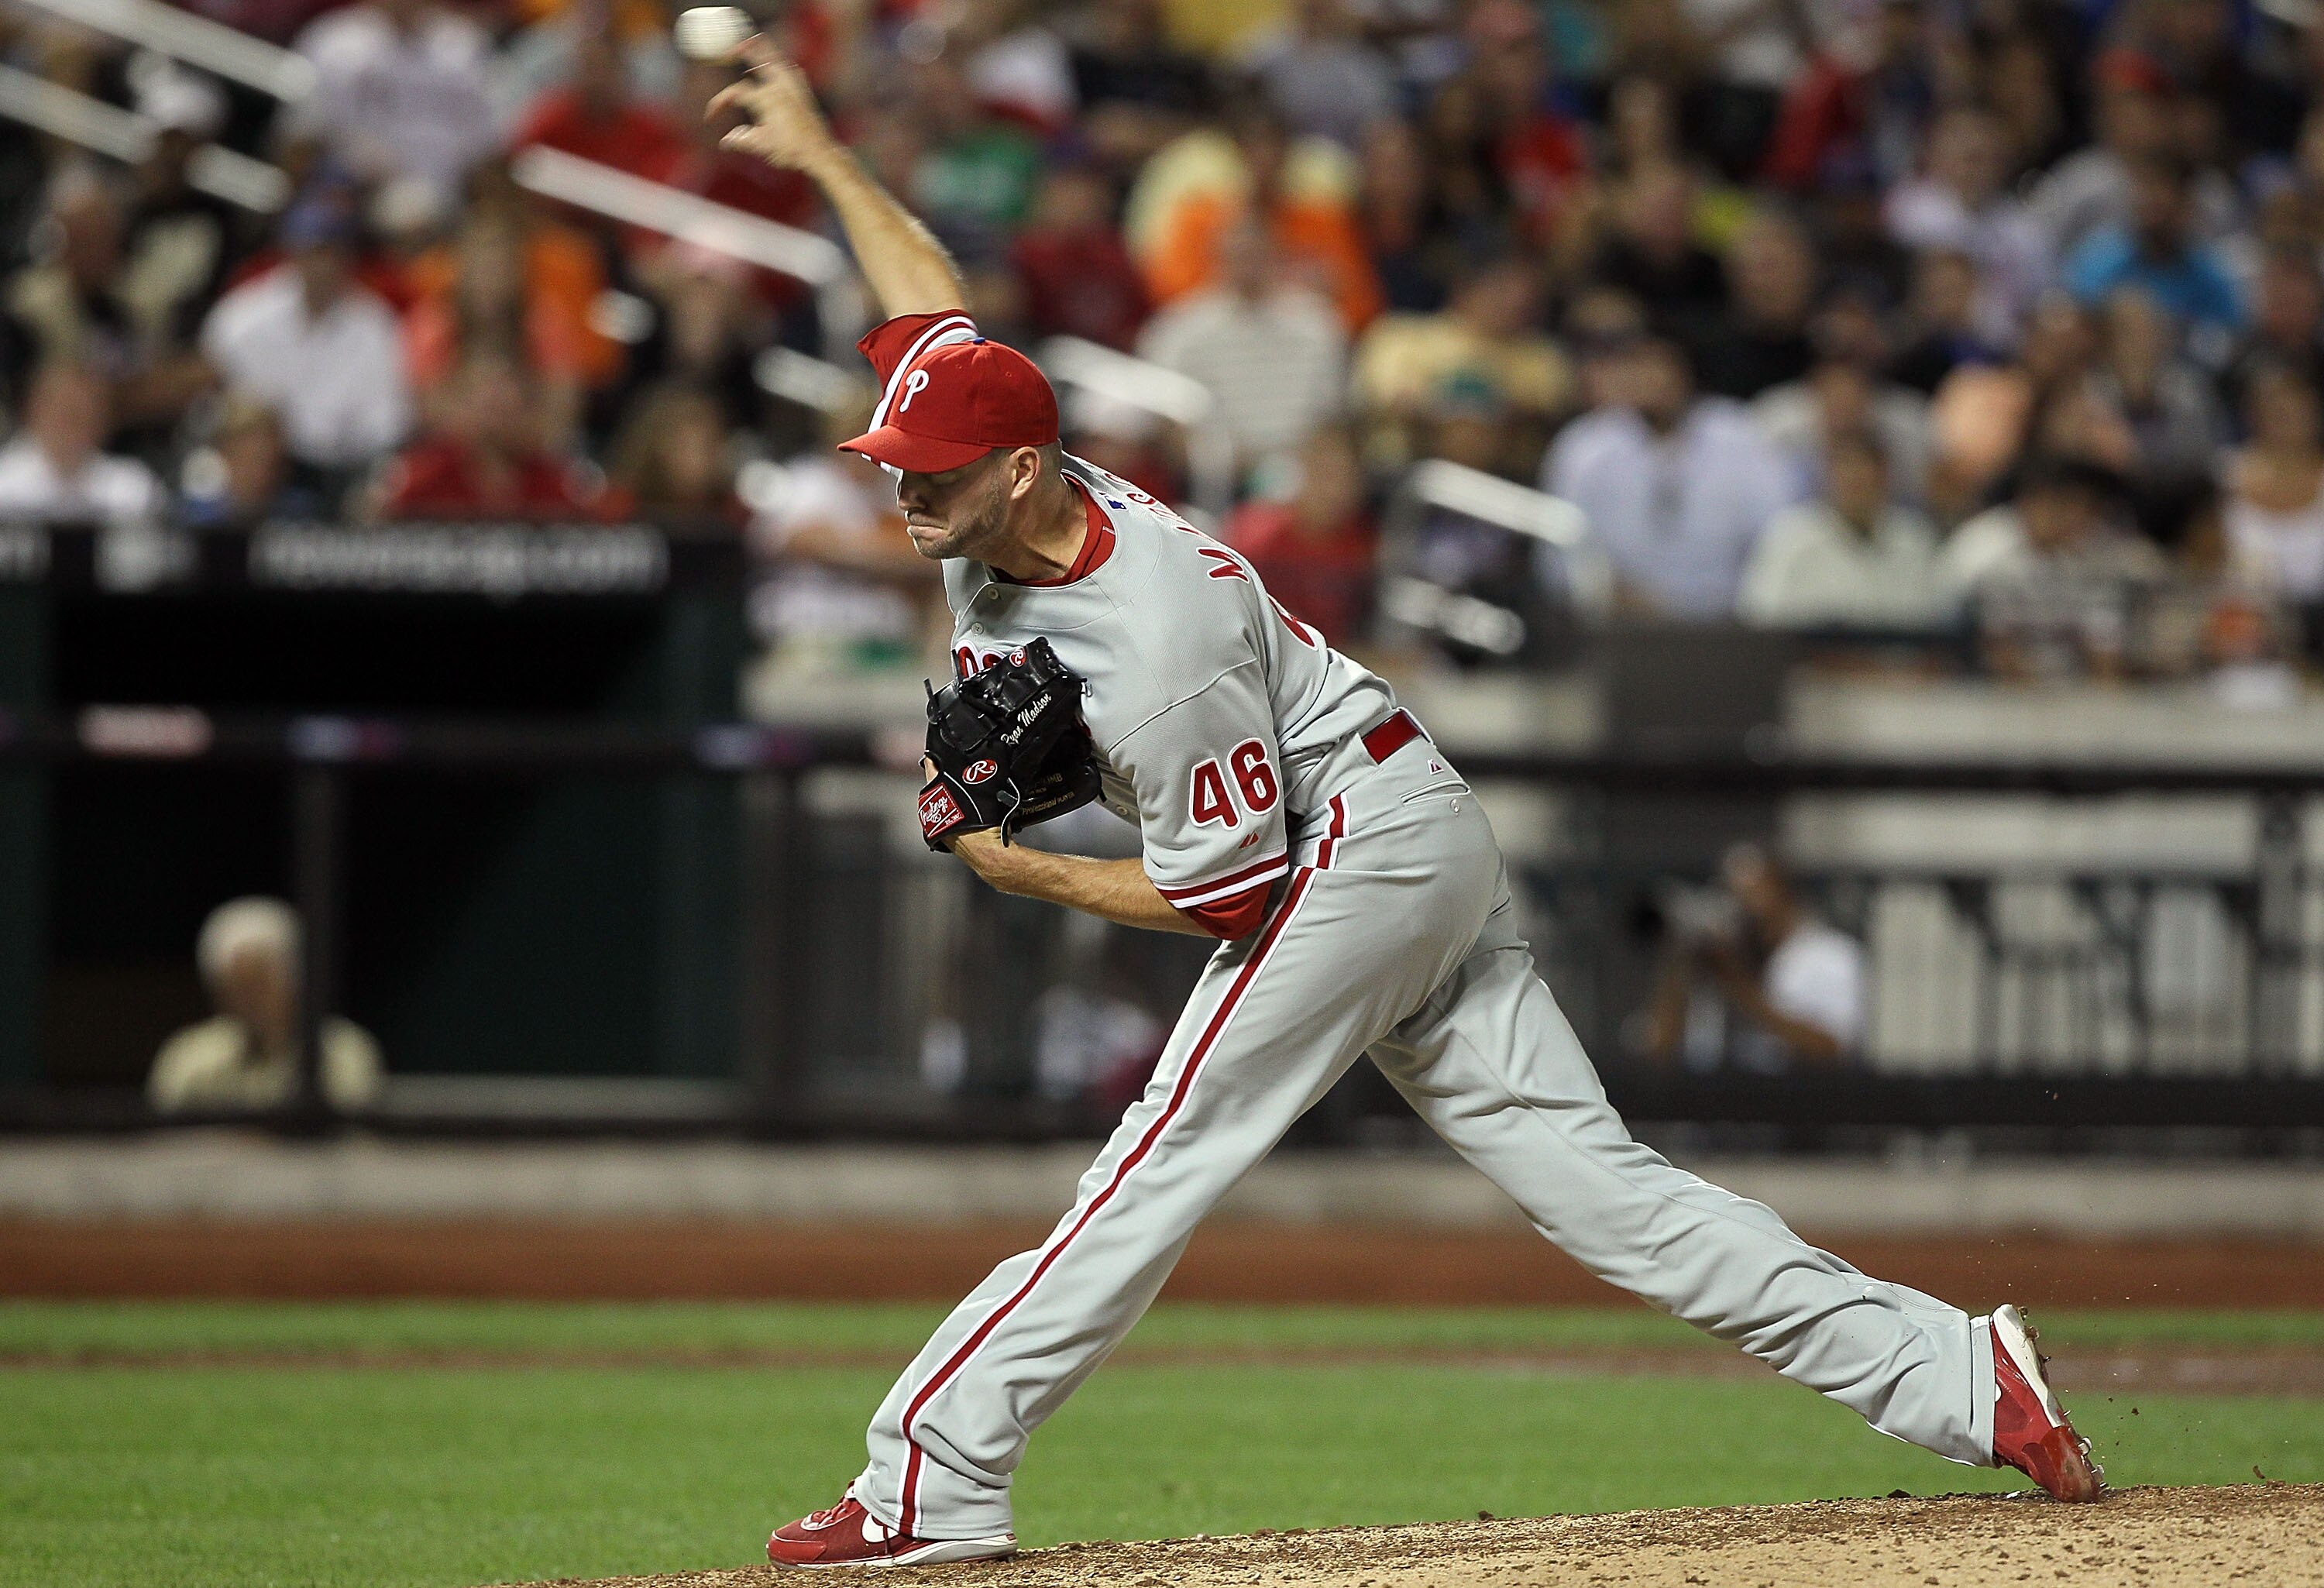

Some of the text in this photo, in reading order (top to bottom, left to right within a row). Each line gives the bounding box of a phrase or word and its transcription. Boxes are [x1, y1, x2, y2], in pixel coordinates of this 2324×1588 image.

[899, 369, 930, 413] P
[1000, 693, 1052, 748] Ryan Madson
[966, 760, 994, 782] R
[1188, 737, 1280, 830] 46
